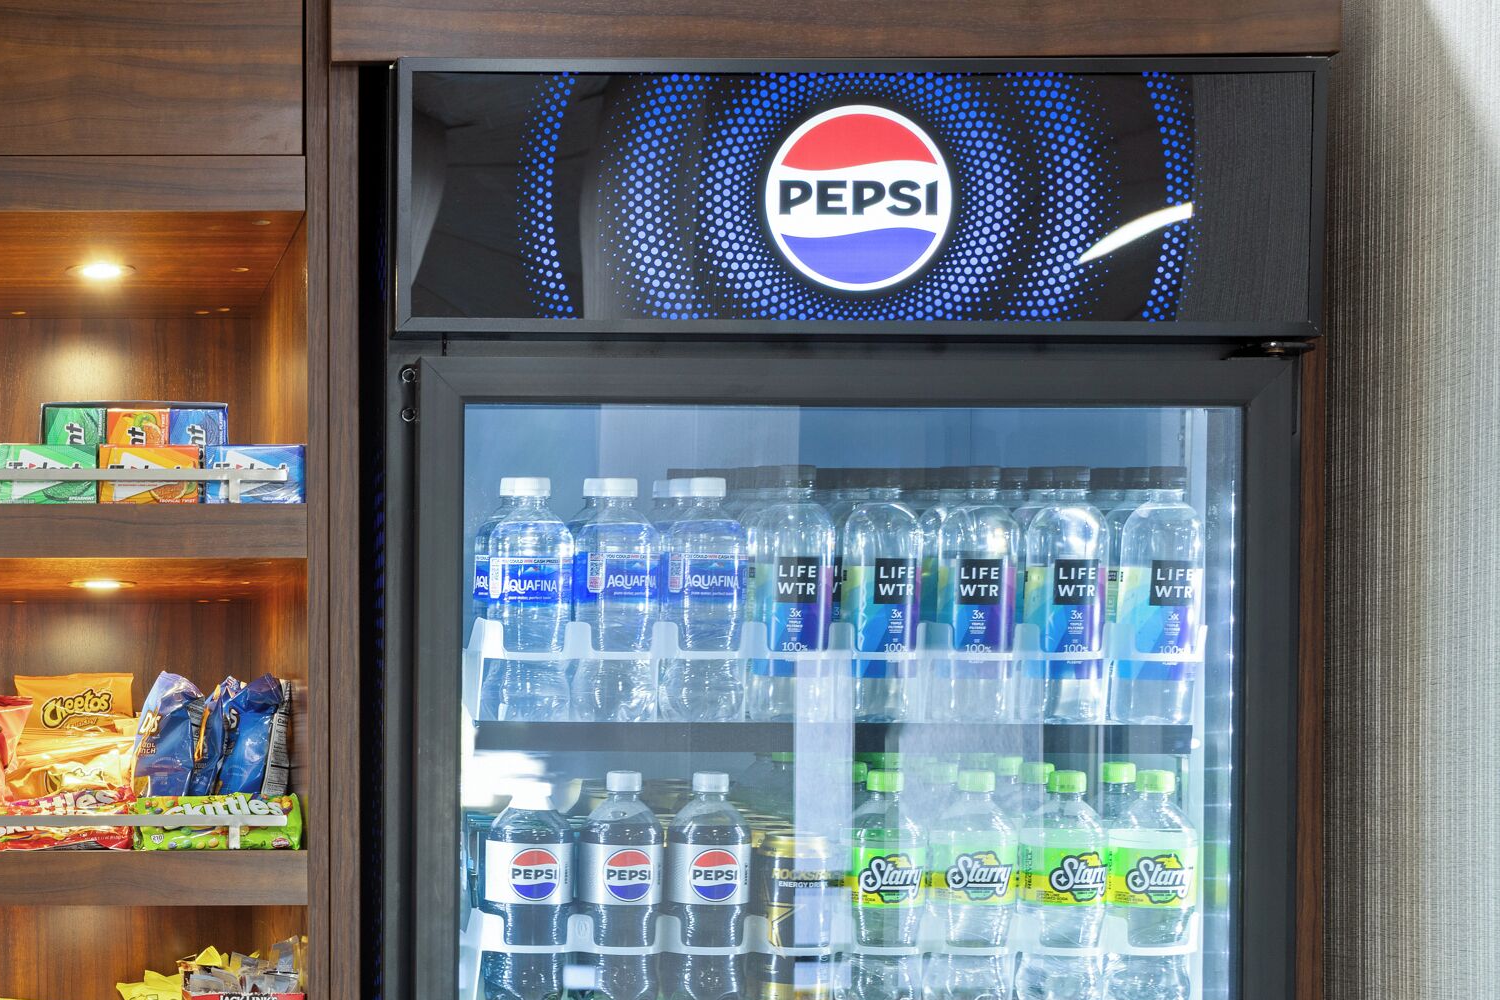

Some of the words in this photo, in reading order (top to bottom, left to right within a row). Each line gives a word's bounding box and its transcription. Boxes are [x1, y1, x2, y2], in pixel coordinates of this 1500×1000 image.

[779, 180, 938, 216] PEPSI
[779, 565, 816, 578] LIFE
[880, 567, 914, 579] LIFE
[961, 567, 999, 580] LIFE
[1059, 567, 1096, 580] LIFE
[1156, 568, 1194, 581] LIFE
[503, 578, 557, 592] AQUAFINA
[685, 575, 739, 590] AQUAFINA
[778, 582, 816, 596] WTR
[879, 584, 914, 596] WTR
[960, 585, 999, 597] WTR
[1058, 585, 1095, 597] WTR
[1156, 585, 1193, 597] WTR
[789, 608, 802, 618] 3x
[890, 609, 903, 620] 3x
[972, 610, 984, 620] 3x
[1070, 609, 1083, 620] 3x
[43, 689, 111, 728] Cheetos
[511, 868, 557, 880] PEPSI
[606, 869, 651, 881] PEPSI
[692, 870, 737, 881] PEPSI
[860, 856, 924, 896] Starry
[949, 856, 1013, 896] Starry
